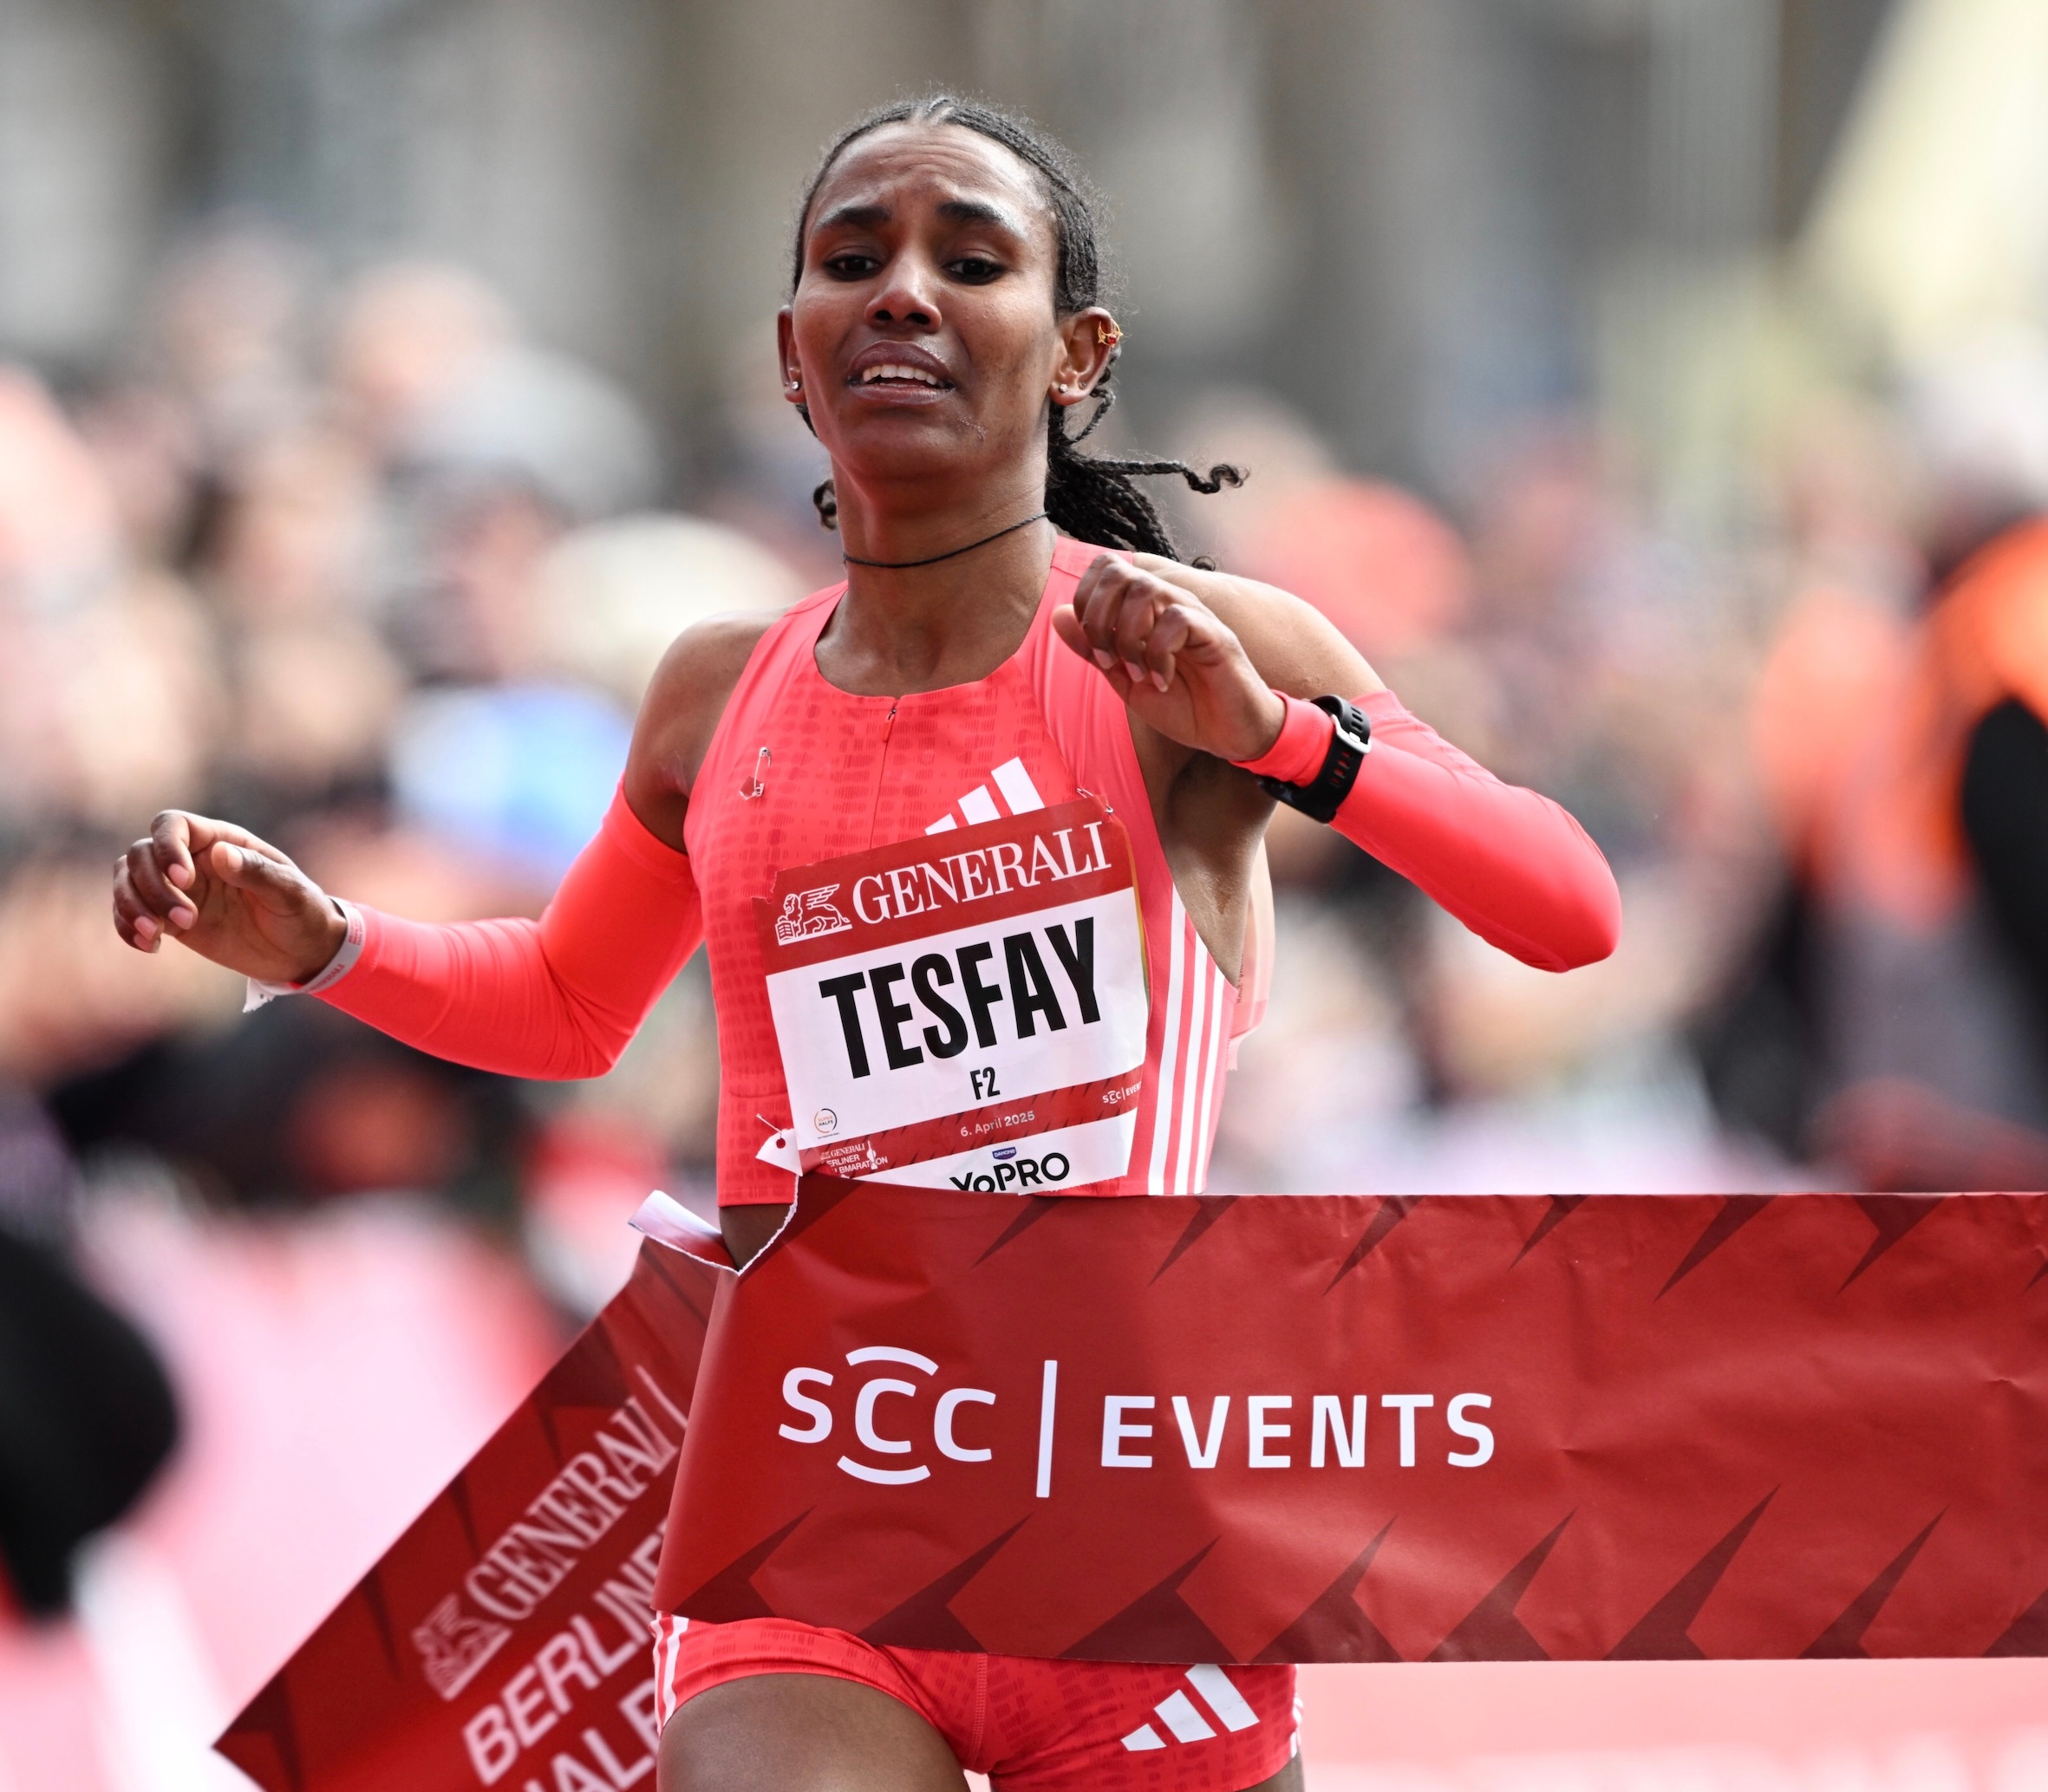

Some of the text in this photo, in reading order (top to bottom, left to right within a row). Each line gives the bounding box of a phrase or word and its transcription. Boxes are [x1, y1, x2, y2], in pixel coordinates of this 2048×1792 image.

[851, 821, 1112, 925] GENERALI
[819, 916, 1101, 1079] TESFAY
[970, 1066, 1001, 1100] F2
[1102, 1091, 1122, 1104] SCC
[960, 1111, 1035, 1137] 6. April 2025
[831, 1143, 865, 1159] GENERALI
[949, 1152, 1070, 1193] YoPRO
[778, 1358, 1495, 1472] SCC EVENTS
